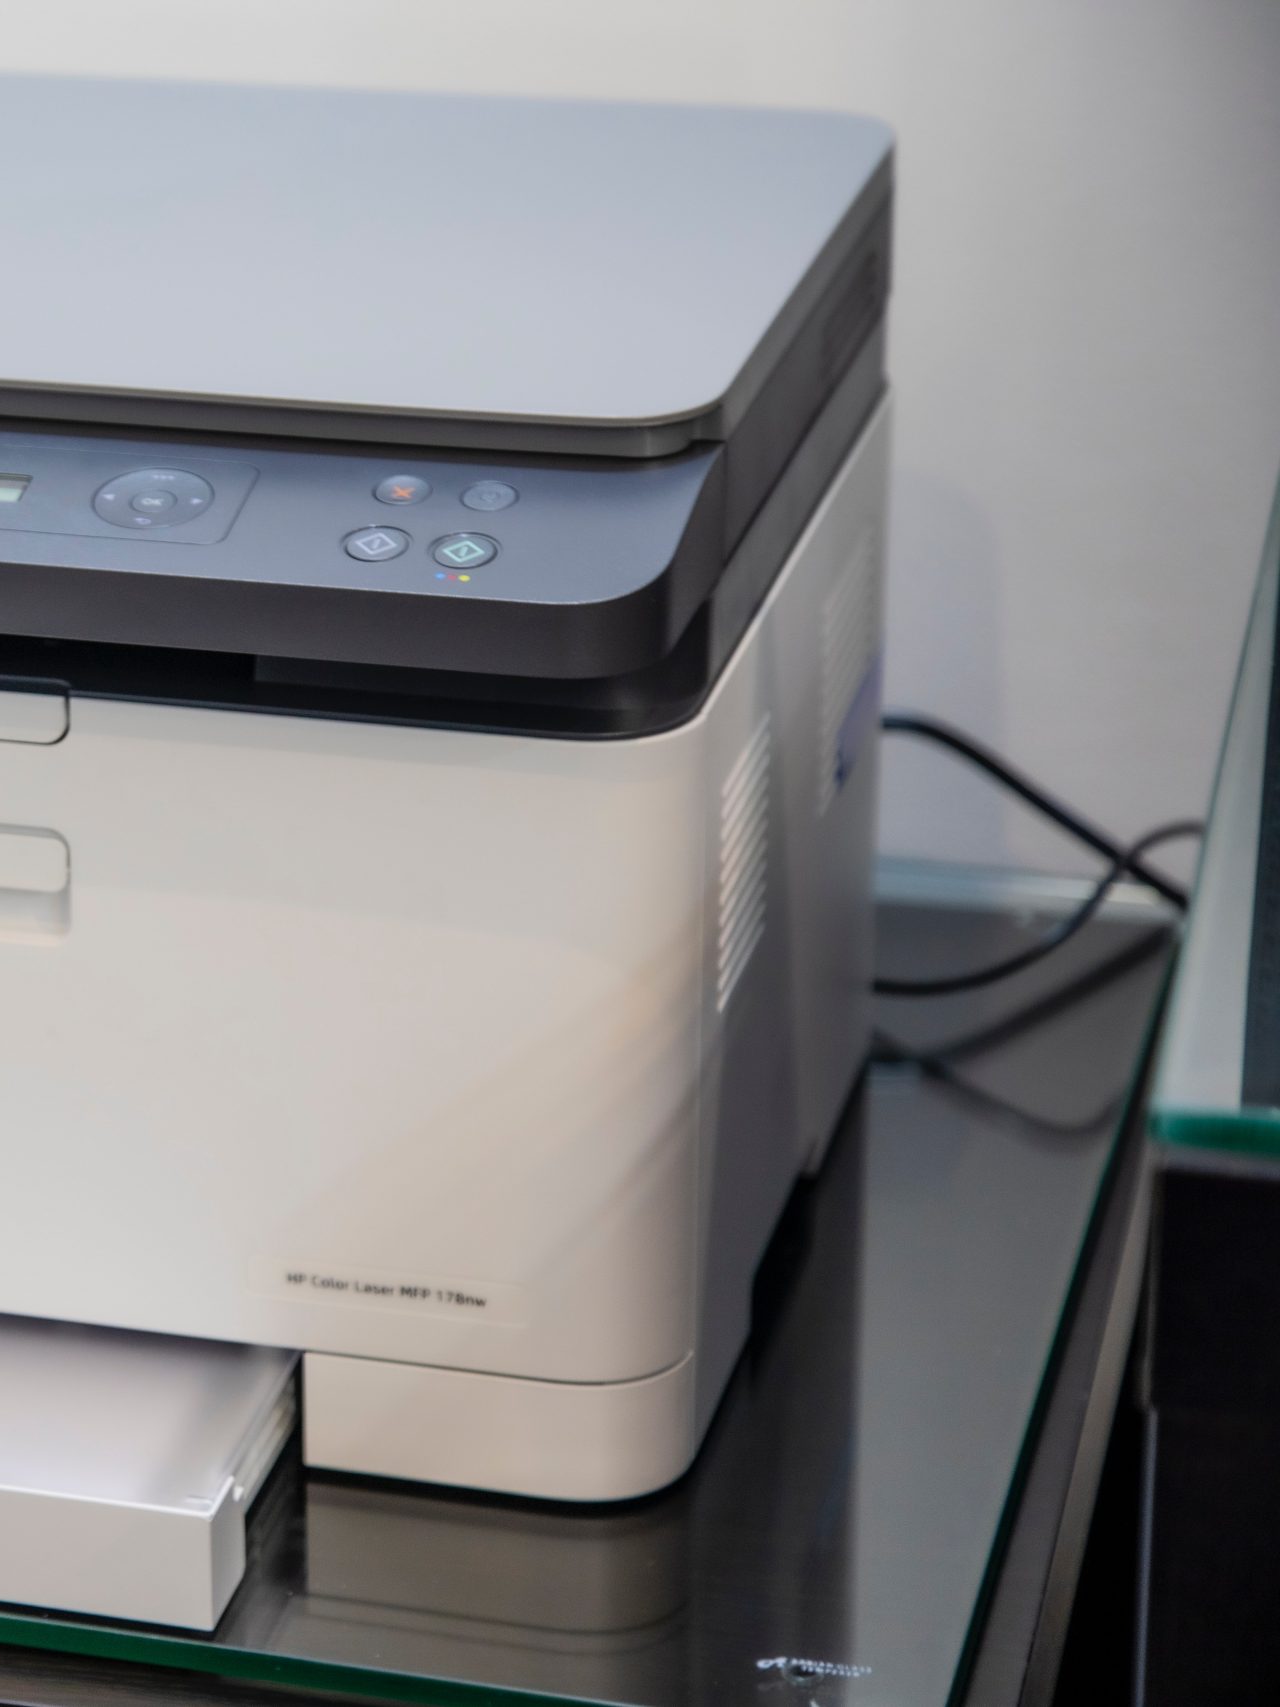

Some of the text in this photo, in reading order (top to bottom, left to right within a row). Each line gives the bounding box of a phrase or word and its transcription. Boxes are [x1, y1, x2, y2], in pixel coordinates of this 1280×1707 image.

[141, 497, 164, 507] OK
[286, 1272, 487, 1308] HP Color Laser MFP 178nw
